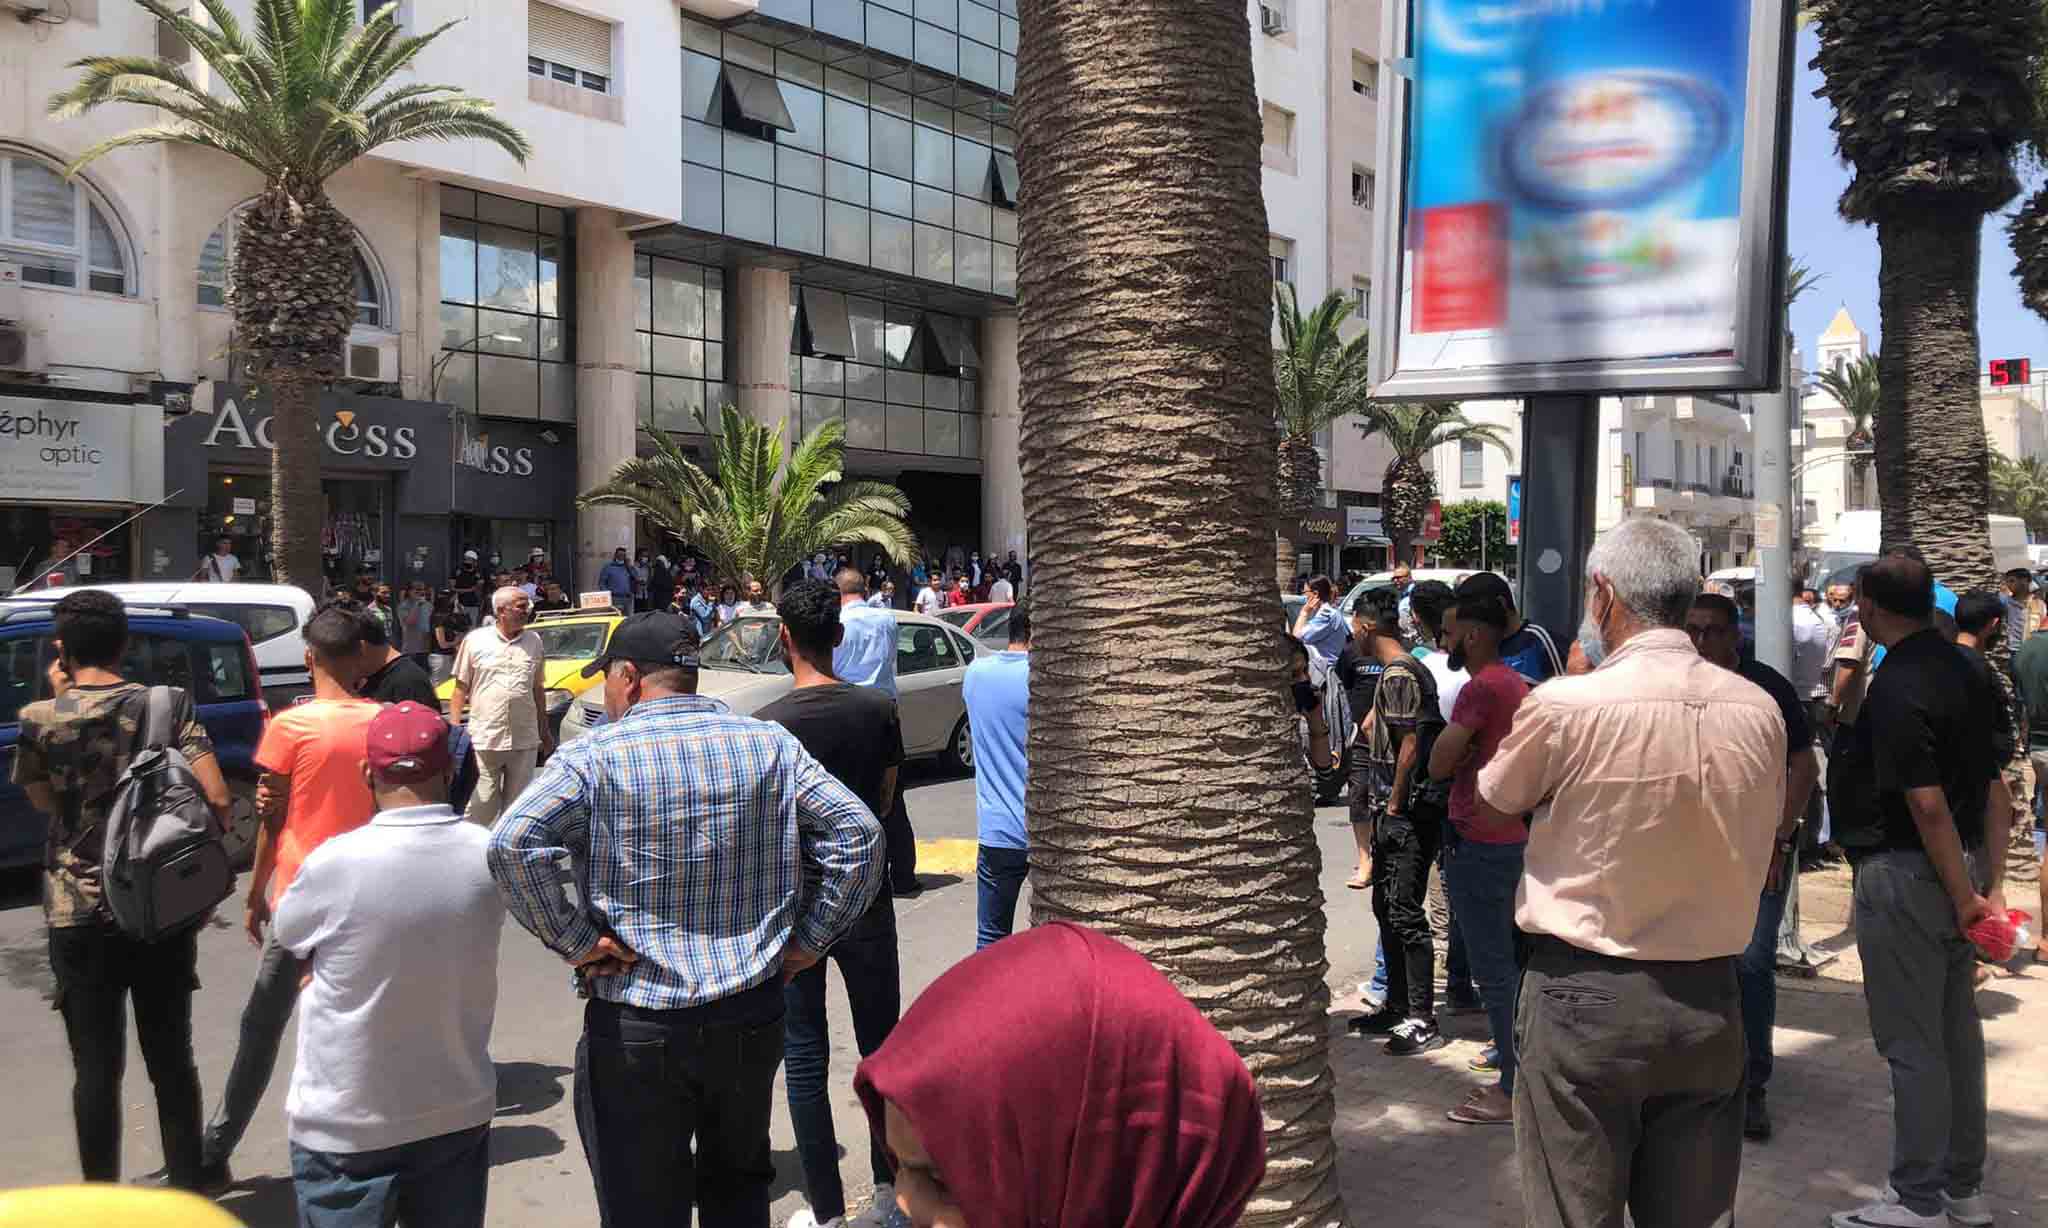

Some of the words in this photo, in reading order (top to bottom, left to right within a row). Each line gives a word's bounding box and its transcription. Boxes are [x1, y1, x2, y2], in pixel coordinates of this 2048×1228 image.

[1989, 359, 2029, 385] 51
[200, 398, 417, 459] Acess
[40, 444, 104, 467] optic
